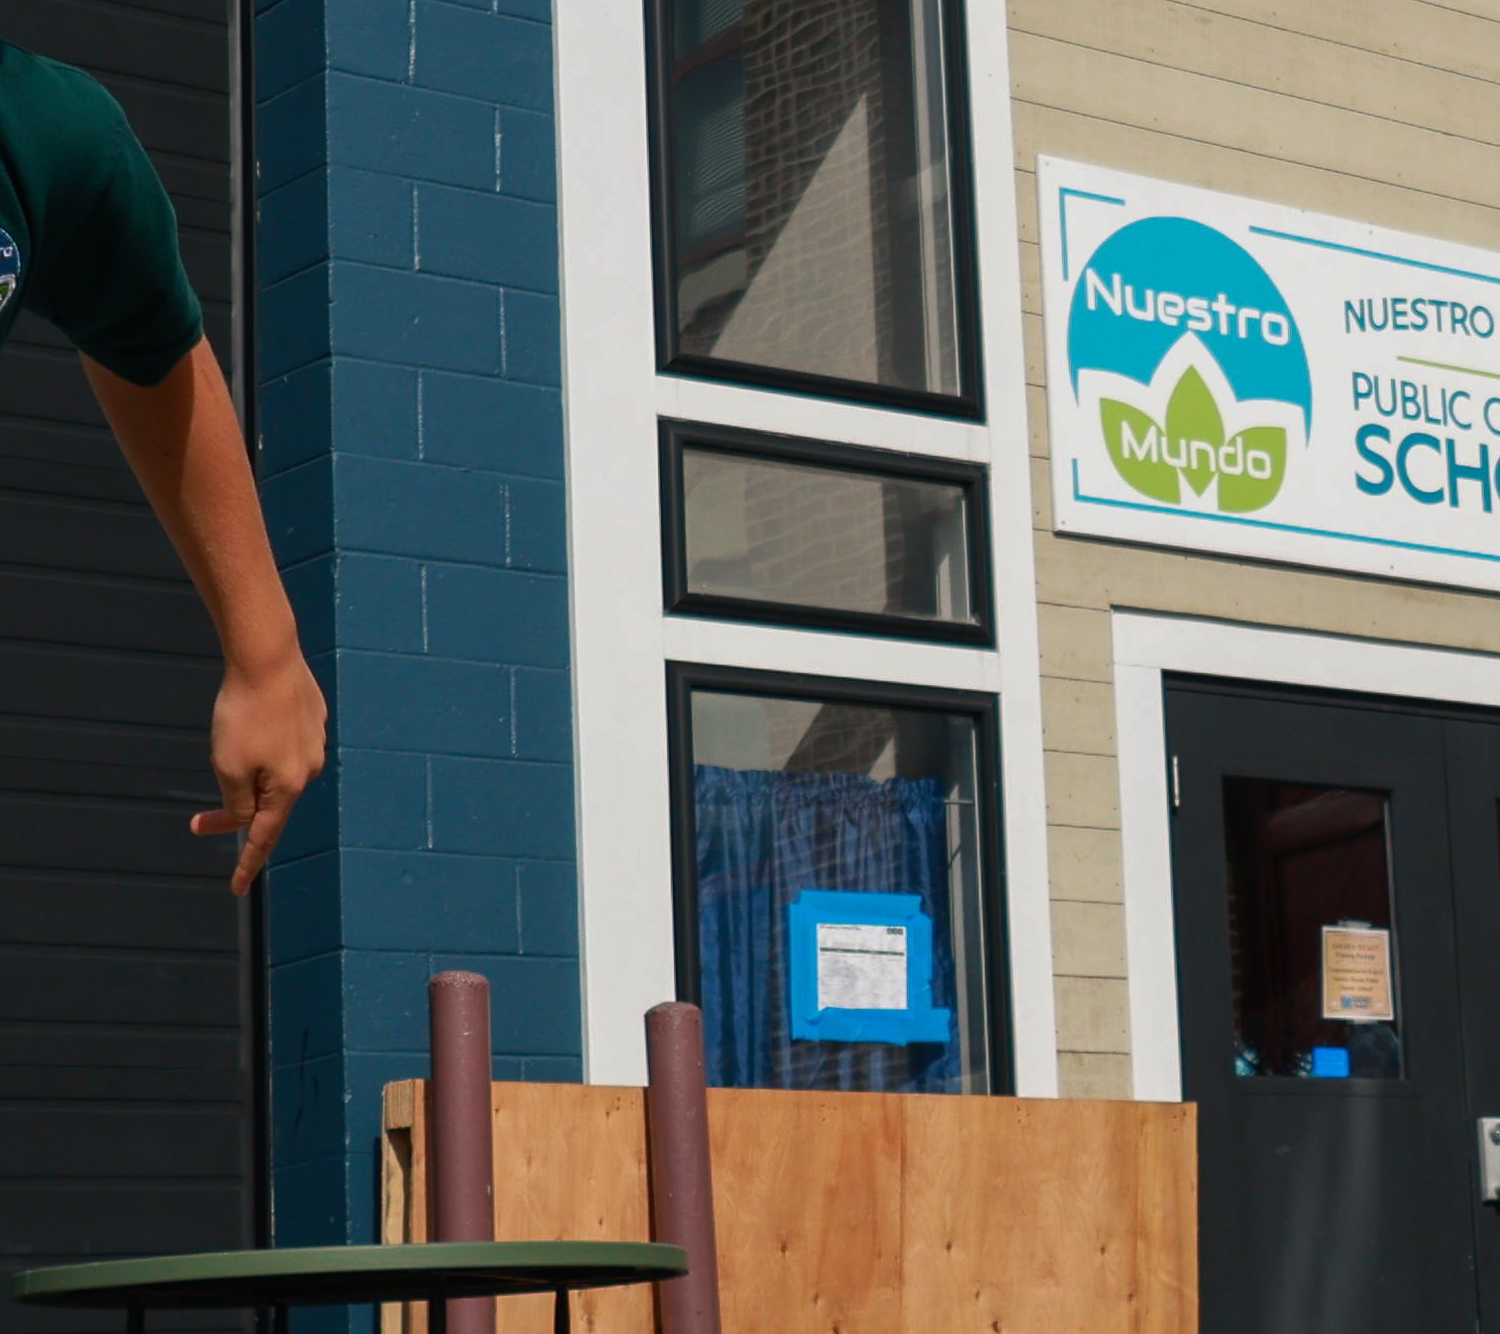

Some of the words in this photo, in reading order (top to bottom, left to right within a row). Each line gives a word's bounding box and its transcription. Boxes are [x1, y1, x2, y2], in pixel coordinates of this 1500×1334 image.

[1085, 266, 1291, 347] Nuestro
[1343, 297, 1495, 339] NUESTRO
[1351, 370, 1473, 431] PUBLIC
[1120, 419, 1272, 480] Mundo
